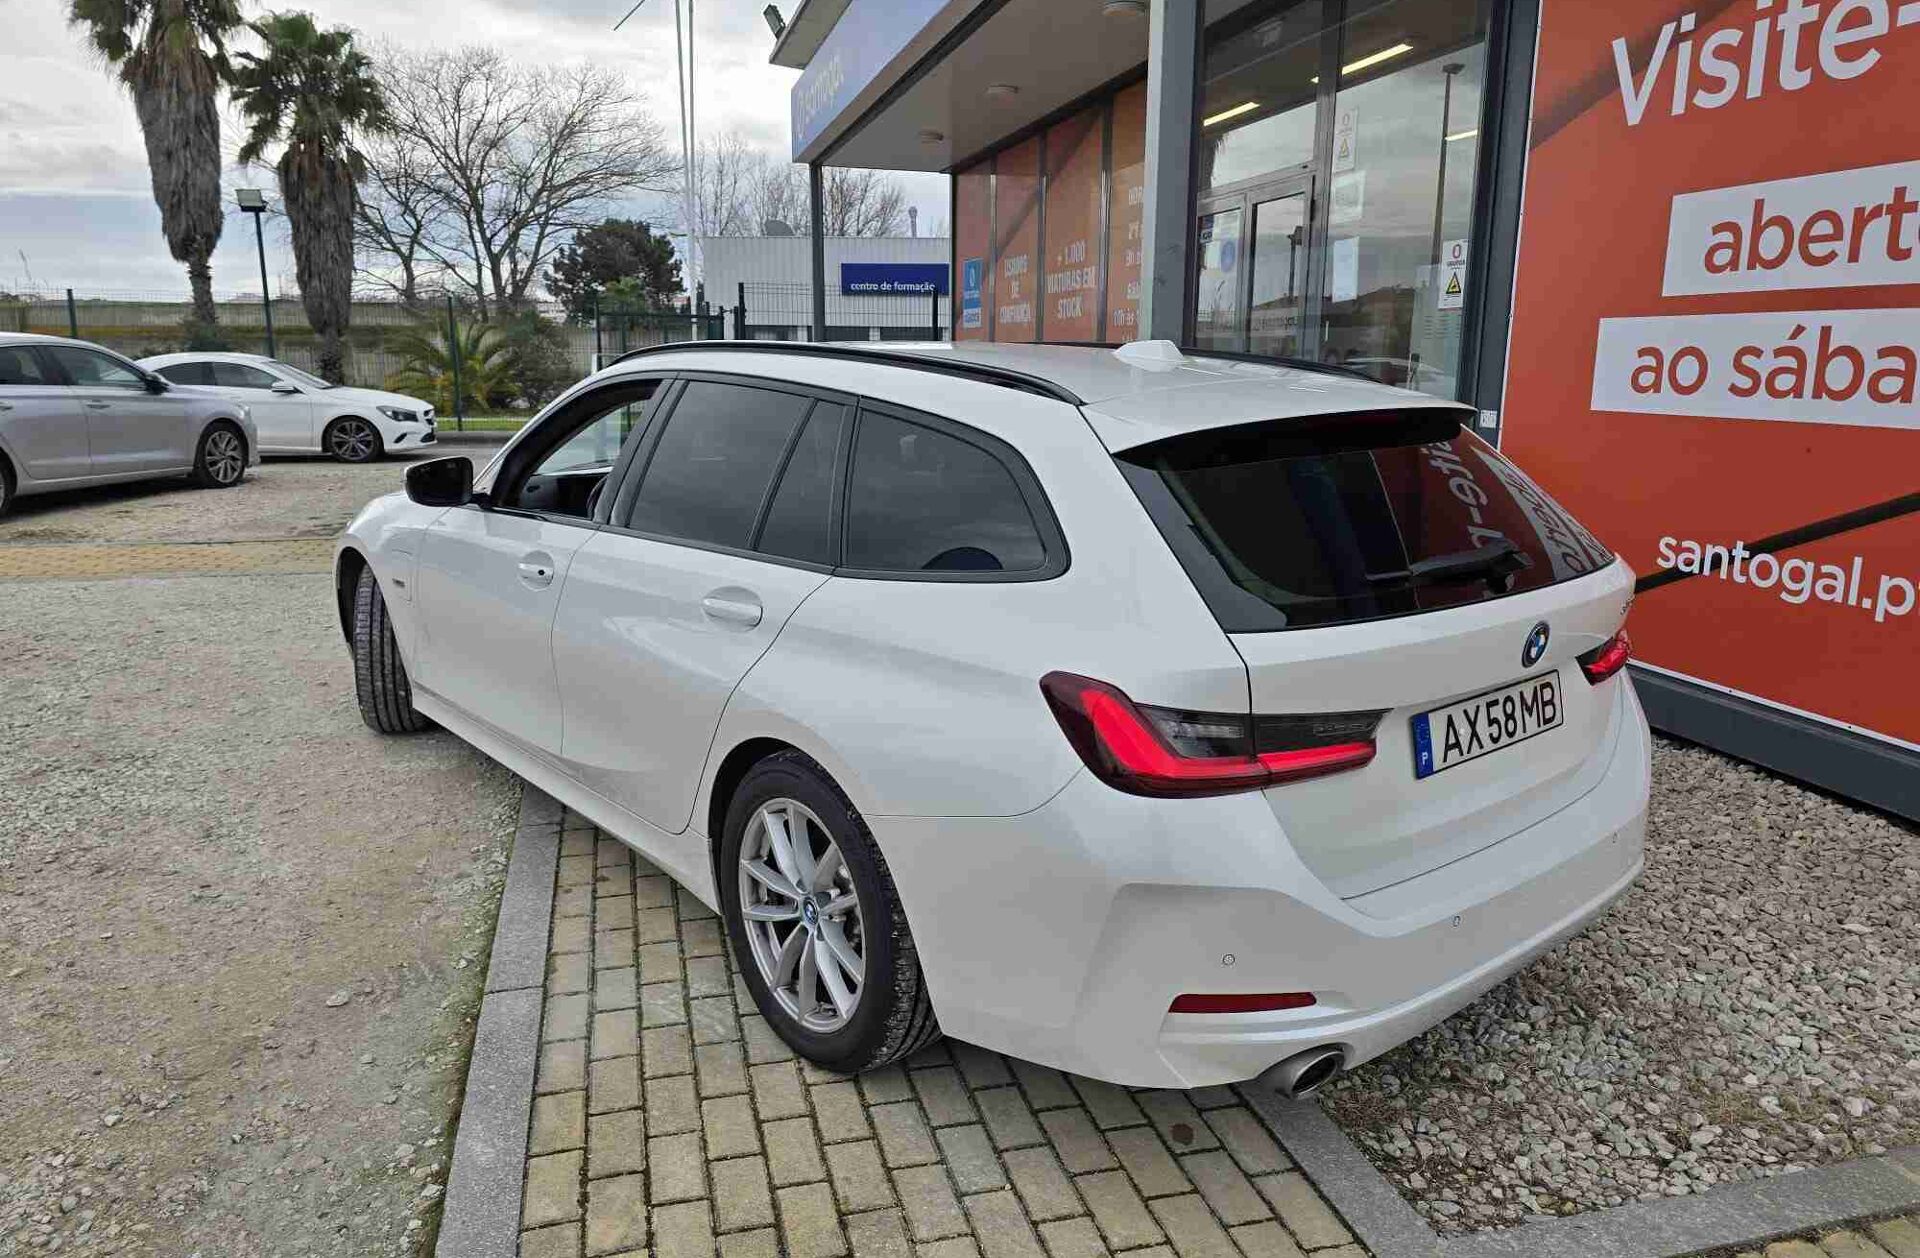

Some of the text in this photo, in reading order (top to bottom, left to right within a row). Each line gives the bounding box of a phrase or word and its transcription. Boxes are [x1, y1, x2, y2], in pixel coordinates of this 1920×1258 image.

[1704, 186, 1920, 275] abert
[850, 281, 935, 293] centro de formação
[1057, 295, 1084, 319] STOCK
[1630, 324, 1918, 404] ao sába
[1656, 536, 1920, 623] santogal.p
[1422, 681, 1556, 765] P AX58MB
